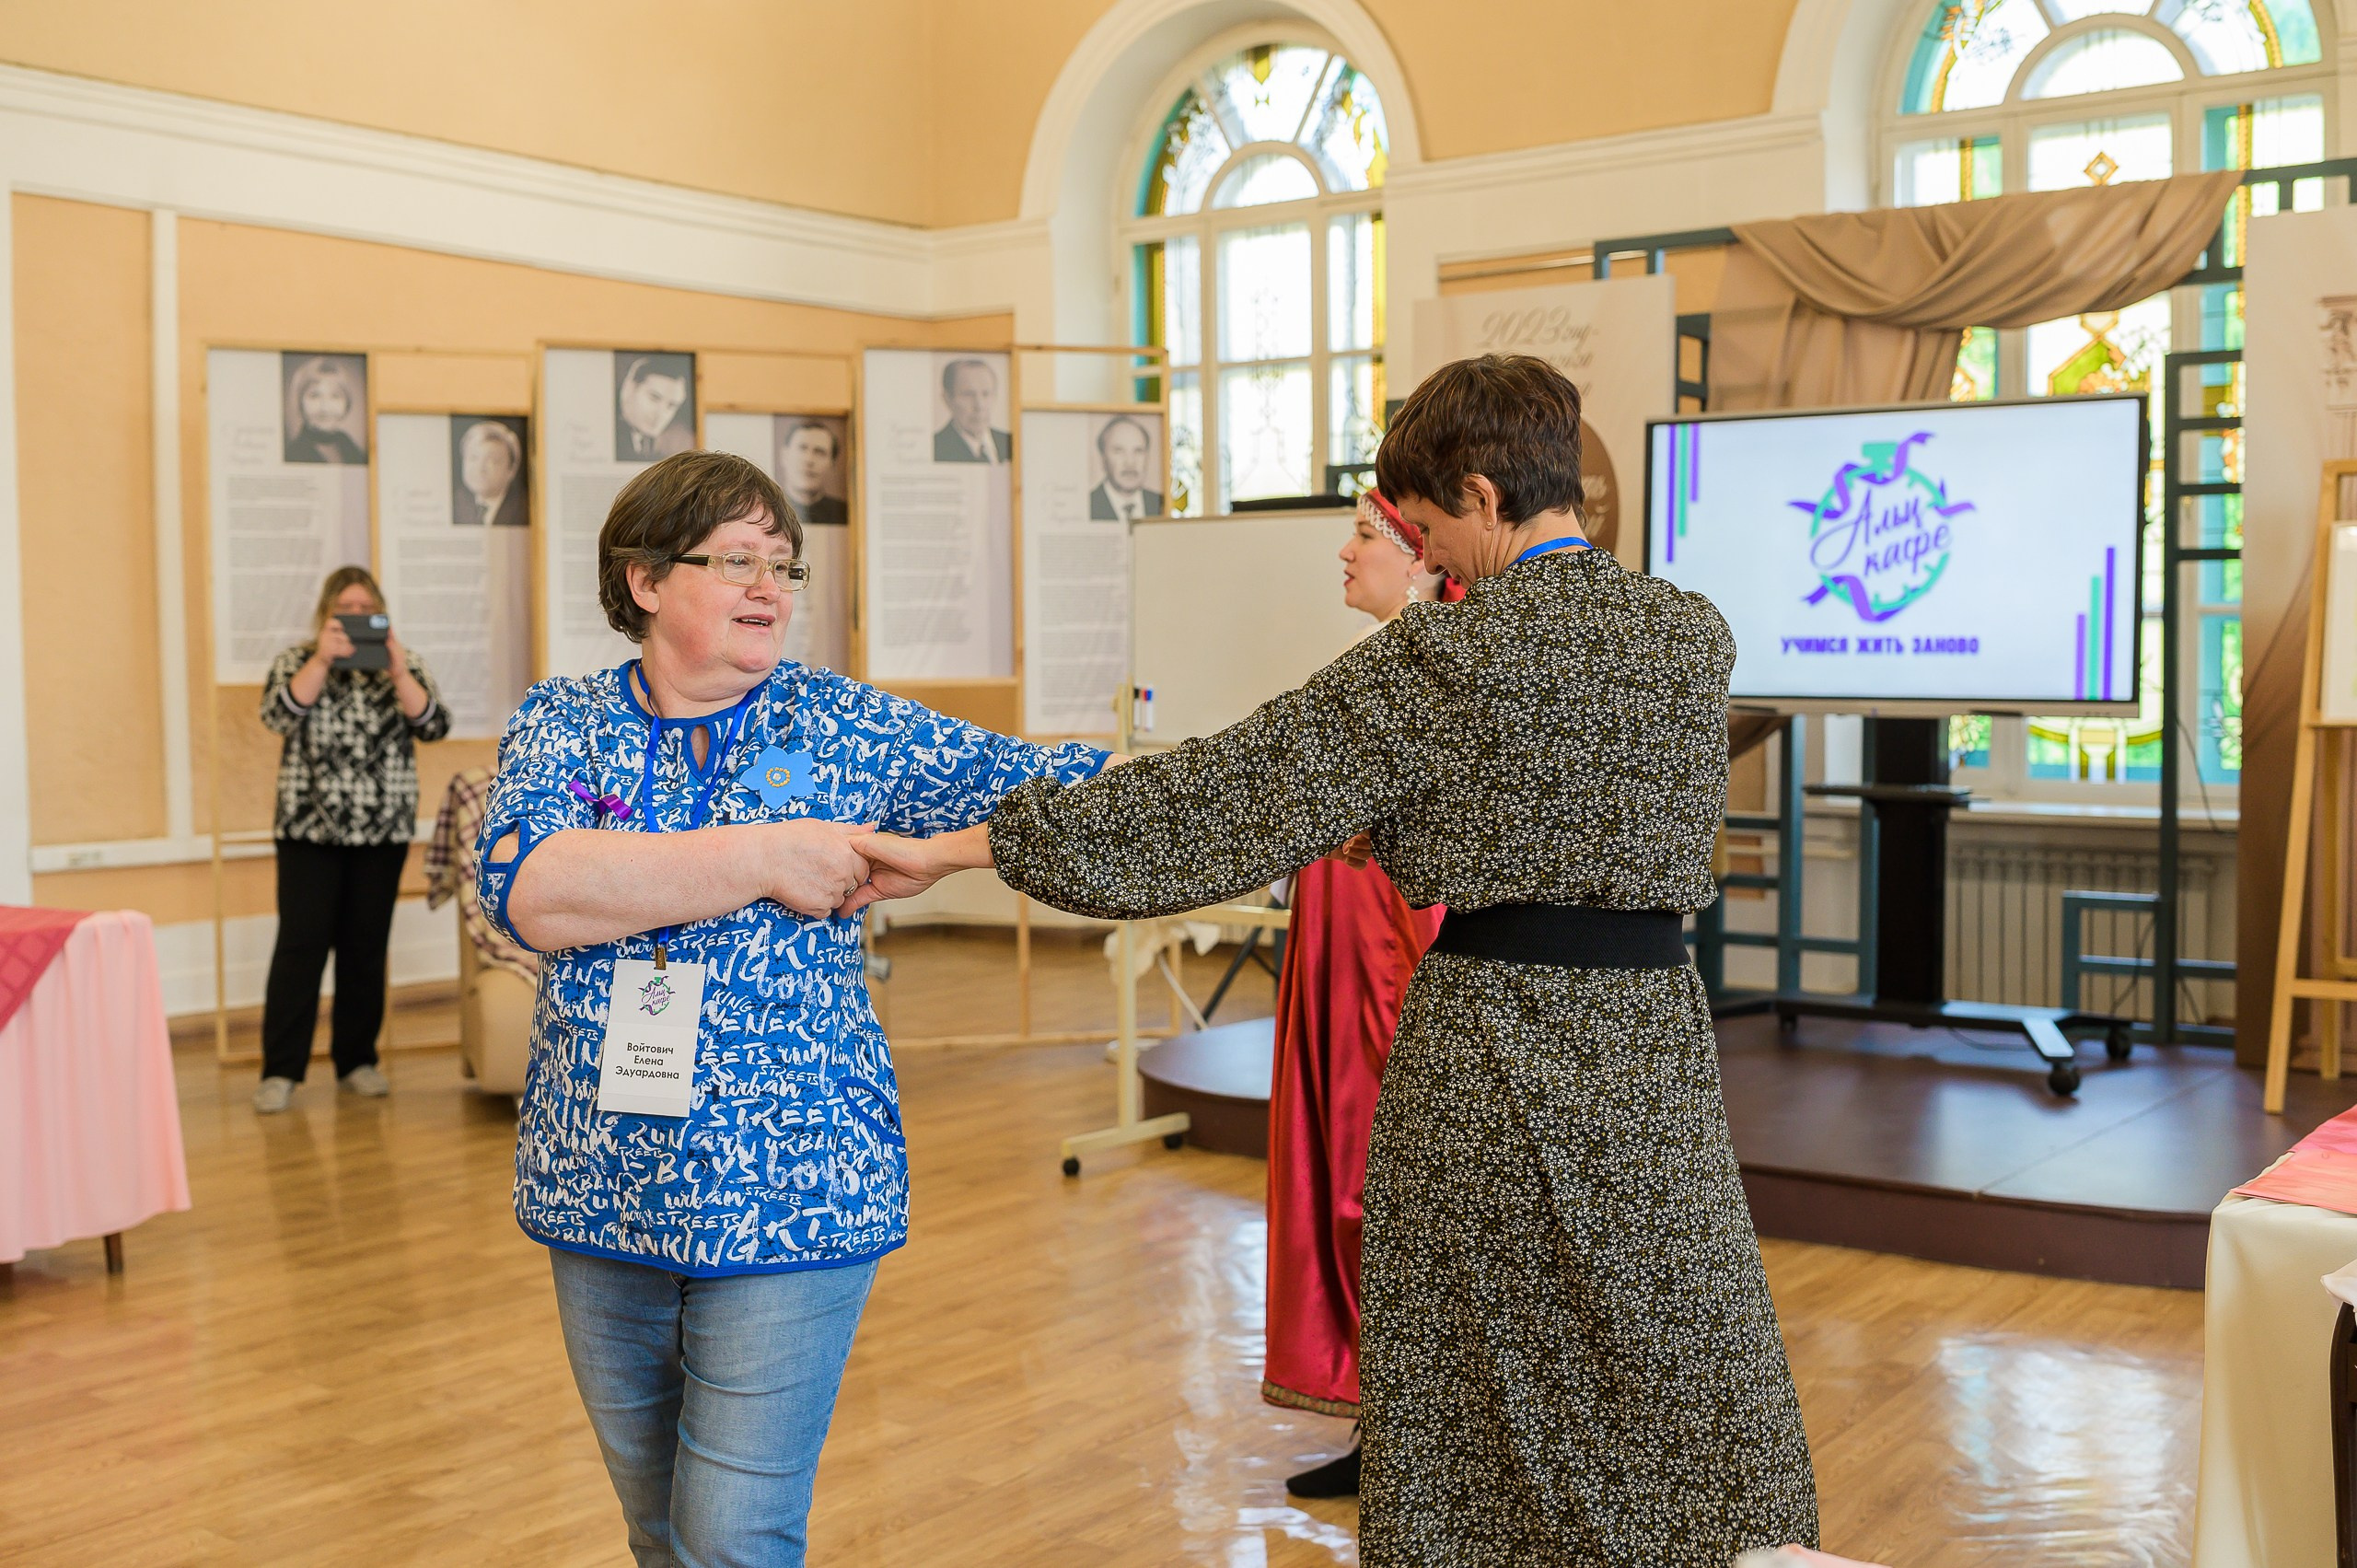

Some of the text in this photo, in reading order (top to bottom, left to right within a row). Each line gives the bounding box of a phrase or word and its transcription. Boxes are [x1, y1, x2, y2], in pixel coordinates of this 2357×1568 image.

[1864, 524, 1951, 576] кафе
[1782, 635, 1980, 656] УЧИМСЯ ЖИТЬ ЗАНОВО
[719, 1003, 841, 1041] ENERGY
[627, 1042, 674, 1055] Войтович
[633, 1055, 664, 1066] Елена
[615, 1066, 680, 1080] Эдуардовна
